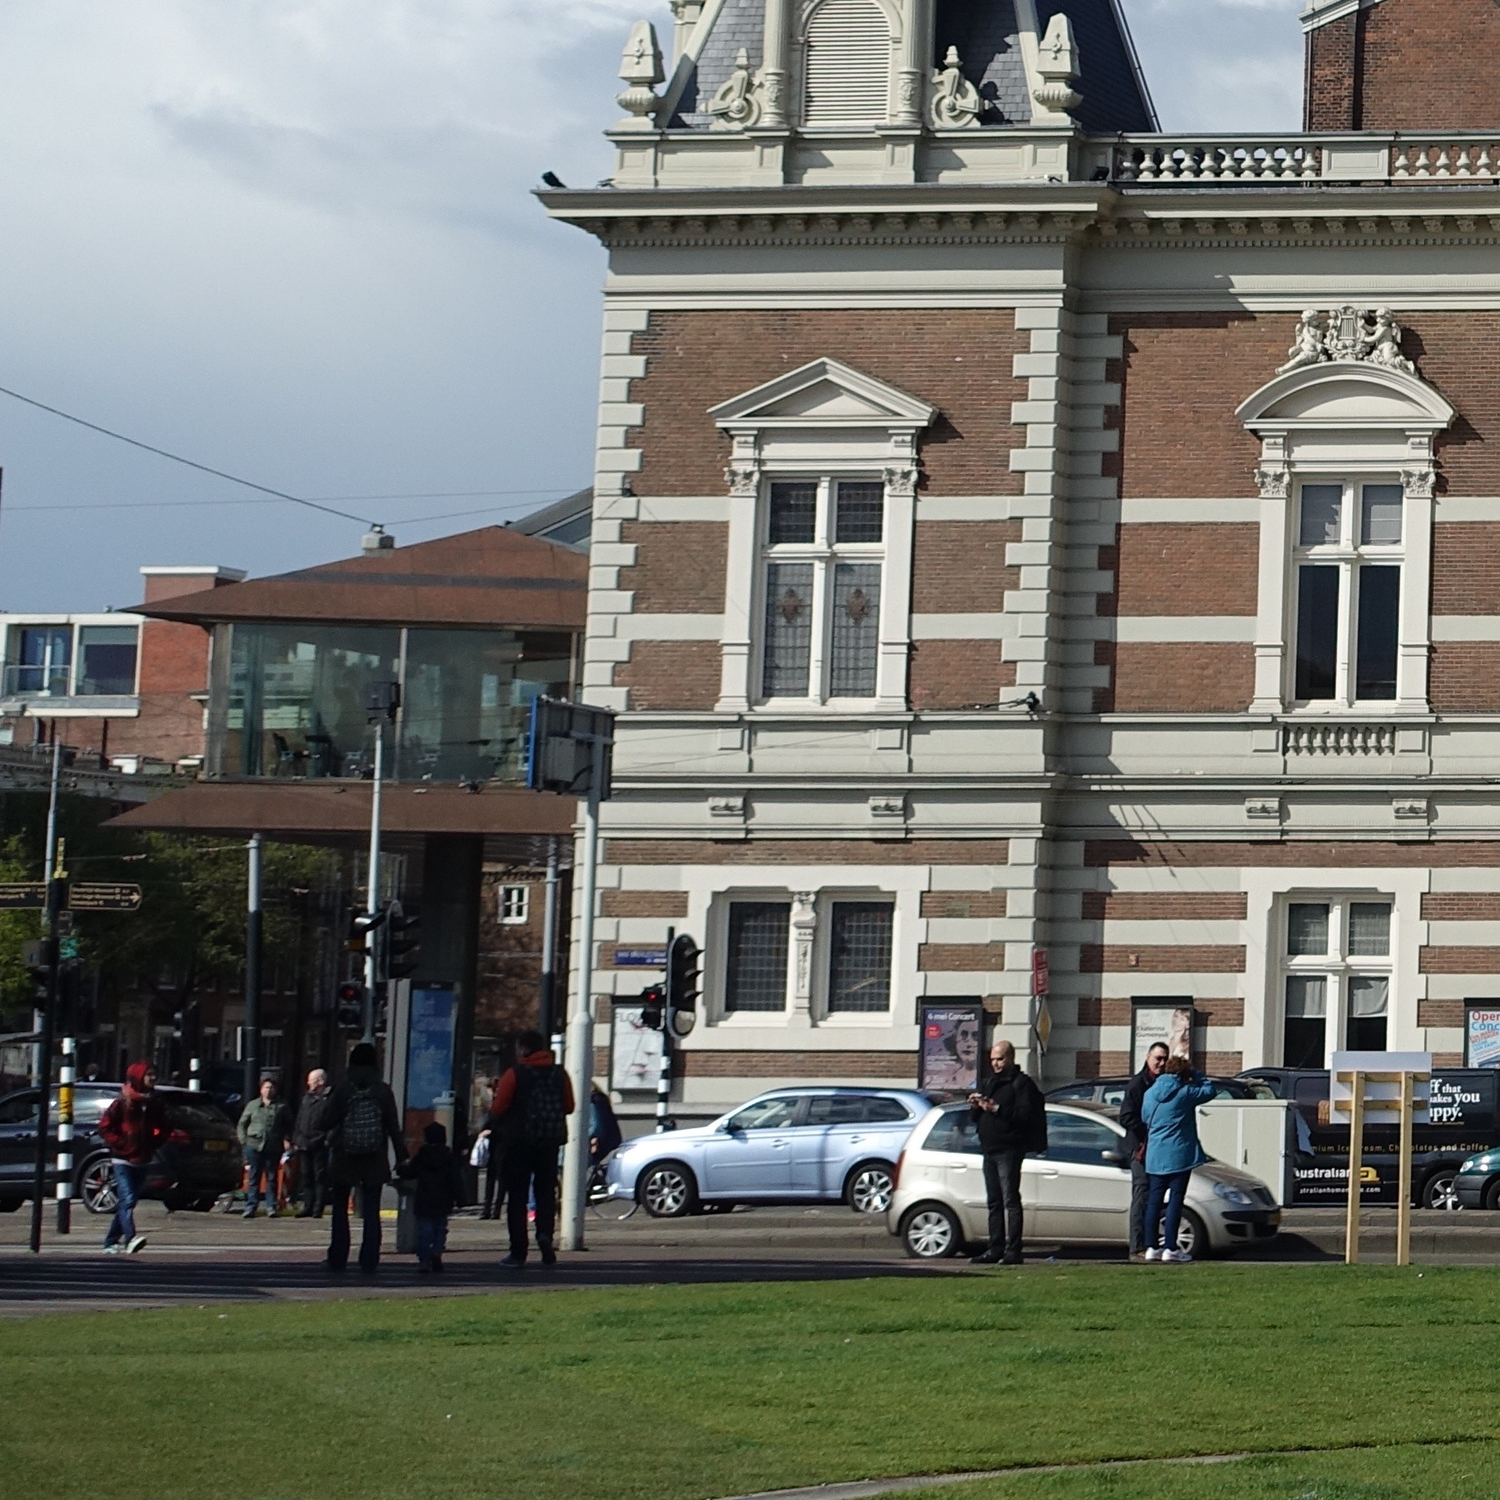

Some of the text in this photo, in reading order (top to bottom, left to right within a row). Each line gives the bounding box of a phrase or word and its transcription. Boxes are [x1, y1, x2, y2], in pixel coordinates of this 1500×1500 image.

[948, 1012, 975, 1021] Concert
[1442, 1083, 1461, 1093] that
[1454, 1093, 1480, 1107] you
[1389, 1143, 1438, 1151] Cholates
[1441, 1143, 1457, 1151] and
[1461, 1143, 1489, 1151] Coffee
